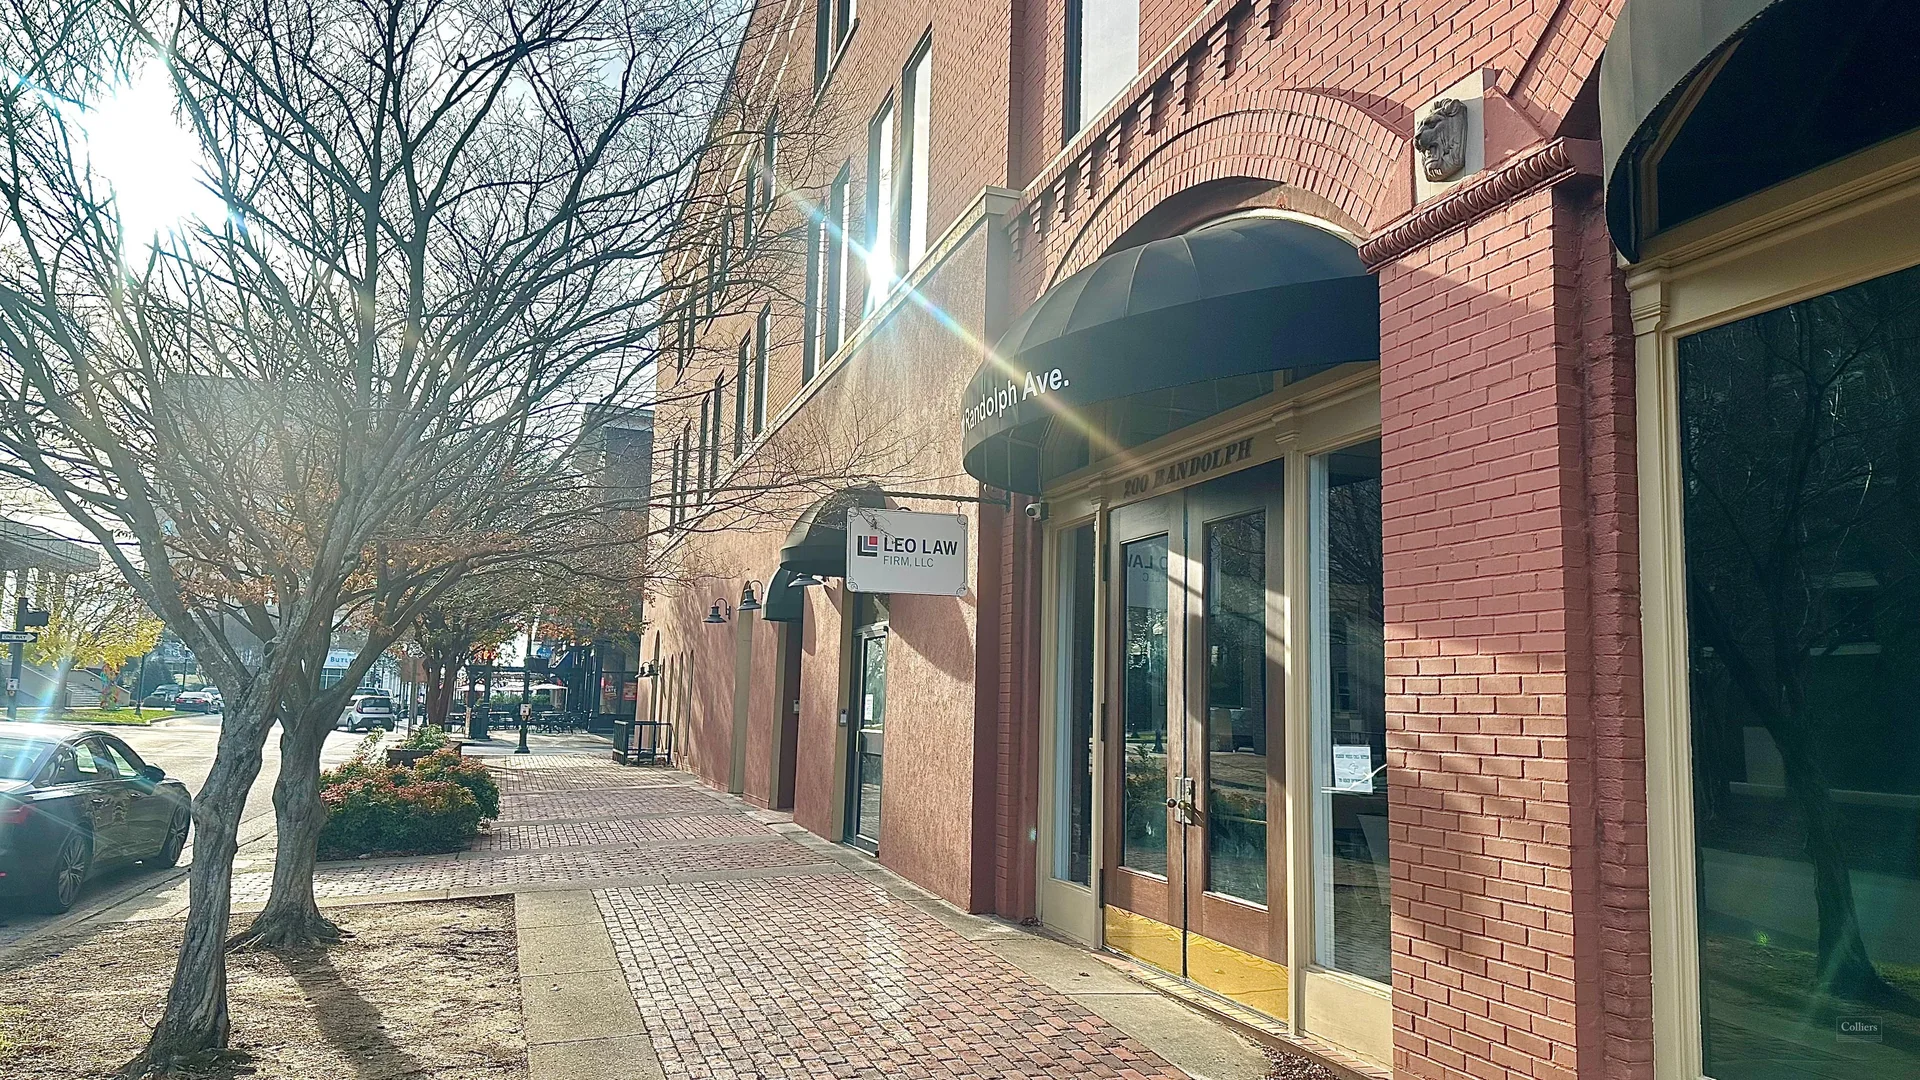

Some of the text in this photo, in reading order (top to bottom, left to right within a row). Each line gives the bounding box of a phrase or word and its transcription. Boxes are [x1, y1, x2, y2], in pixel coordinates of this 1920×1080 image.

[965, 380, 1018, 433] Randolph
[1022, 368, 1070, 401] Ave.
[1123, 437, 1254, 498] 200 RANDOLPH
[883, 536, 958, 556] LEO LAW
[883, 556, 934, 568] FIRM, LLC
